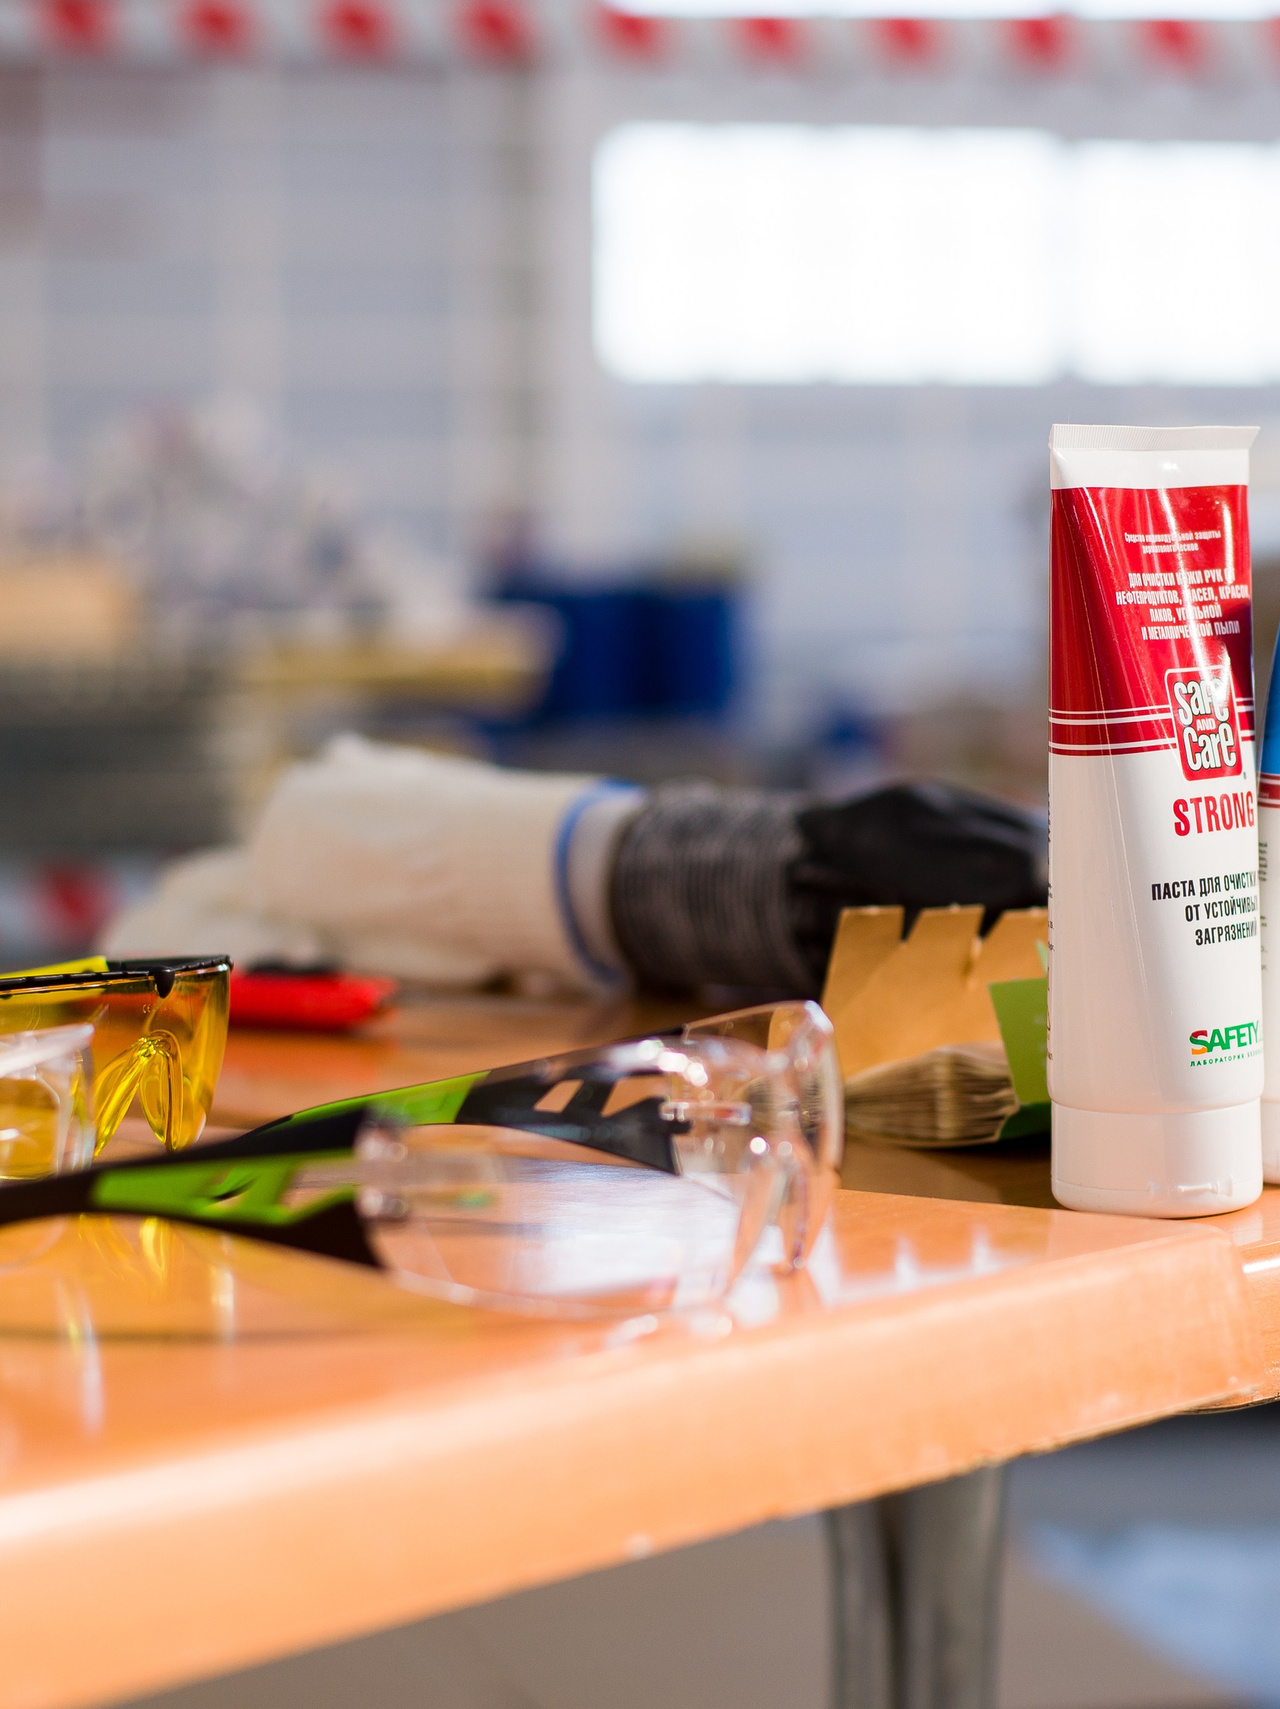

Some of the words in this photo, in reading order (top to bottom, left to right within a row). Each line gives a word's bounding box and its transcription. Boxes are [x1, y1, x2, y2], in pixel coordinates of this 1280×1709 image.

[1142, 571, 1176, 587] ОЧИСТКИ
[1204, 568, 1223, 584] РУК
[1148, 621, 1213, 640] МЕТАЛЛИЧЕКОЙ
[1214, 620, 1241, 636] ПЫЛИ
[1196, 717, 1216, 732] AND
[1183, 721, 1237, 772] Care
[1172, 790, 1255, 837] STRONG
[1151, 879, 1196, 901] ПАСТА
[1199, 876, 1222, 897] ДЛЯ
[1185, 903, 1200, 922] ОТ
[1203, 895, 1258, 920] УСТОЙЧИВЫ
[1189, 1019, 1259, 1055] SAFETY
[1190, 1053, 1245, 1067] ЛАБОРАТОРИЯ
